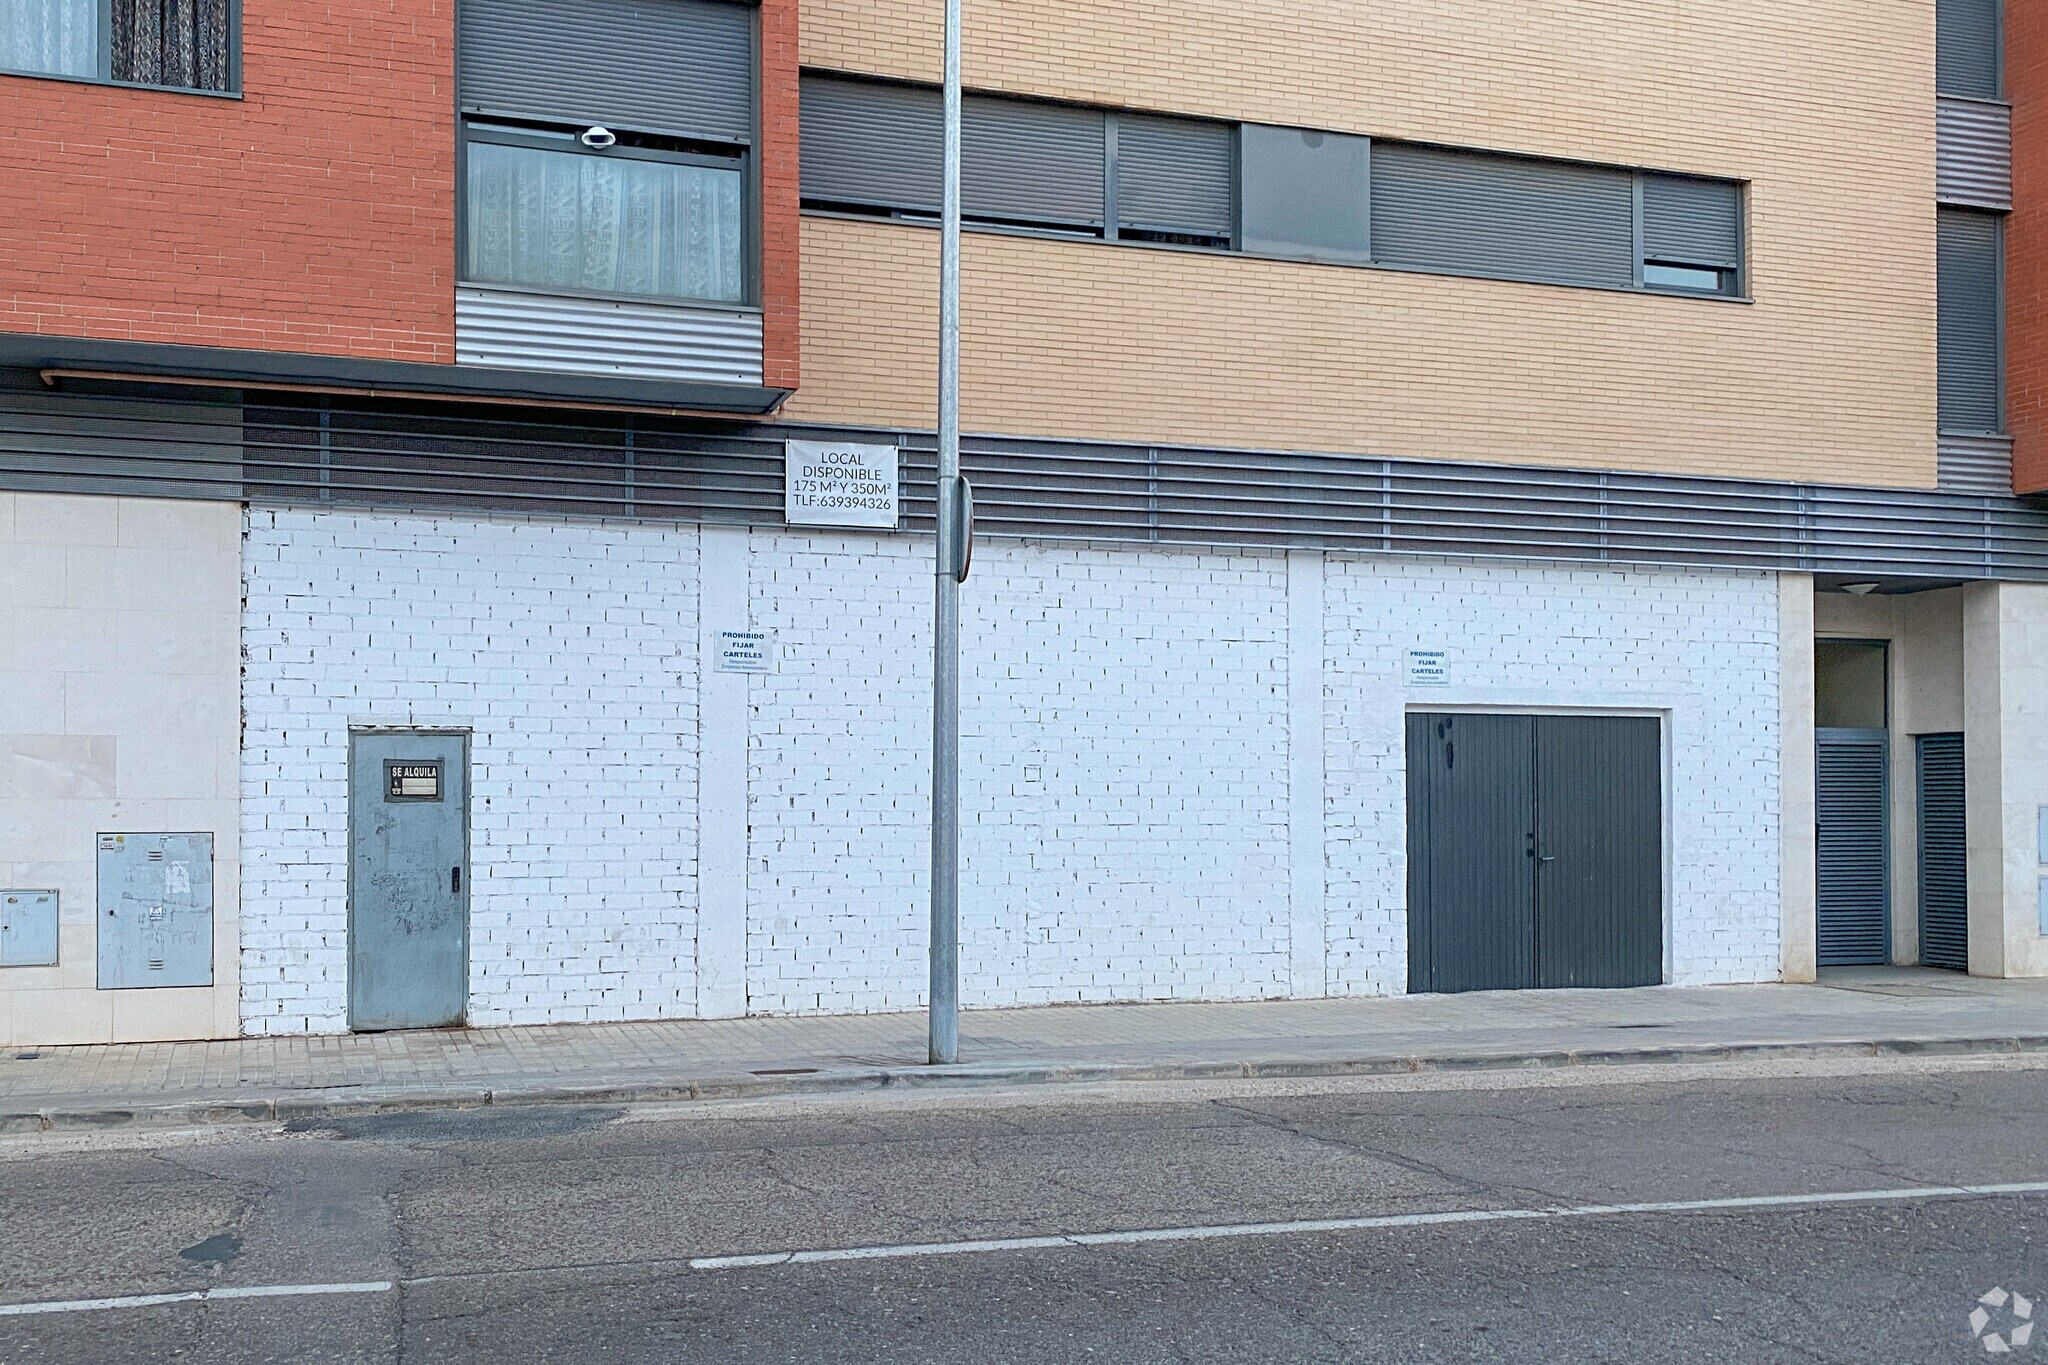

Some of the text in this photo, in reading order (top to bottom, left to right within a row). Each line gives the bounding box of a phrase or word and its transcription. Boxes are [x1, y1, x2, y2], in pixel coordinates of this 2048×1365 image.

[821, 452, 864, 466] LOCAL
[803, 465, 882, 481] DISPONIBLE
[793, 480, 817, 492] 175
[839, 482, 849, 493] Y
[793, 494, 891, 510] TLF:639394326
[722, 631, 765, 640] PROHIBIDO
[723, 650, 763, 659] CARTELES
[392, 766, 437, 778] SE ALQUILA
